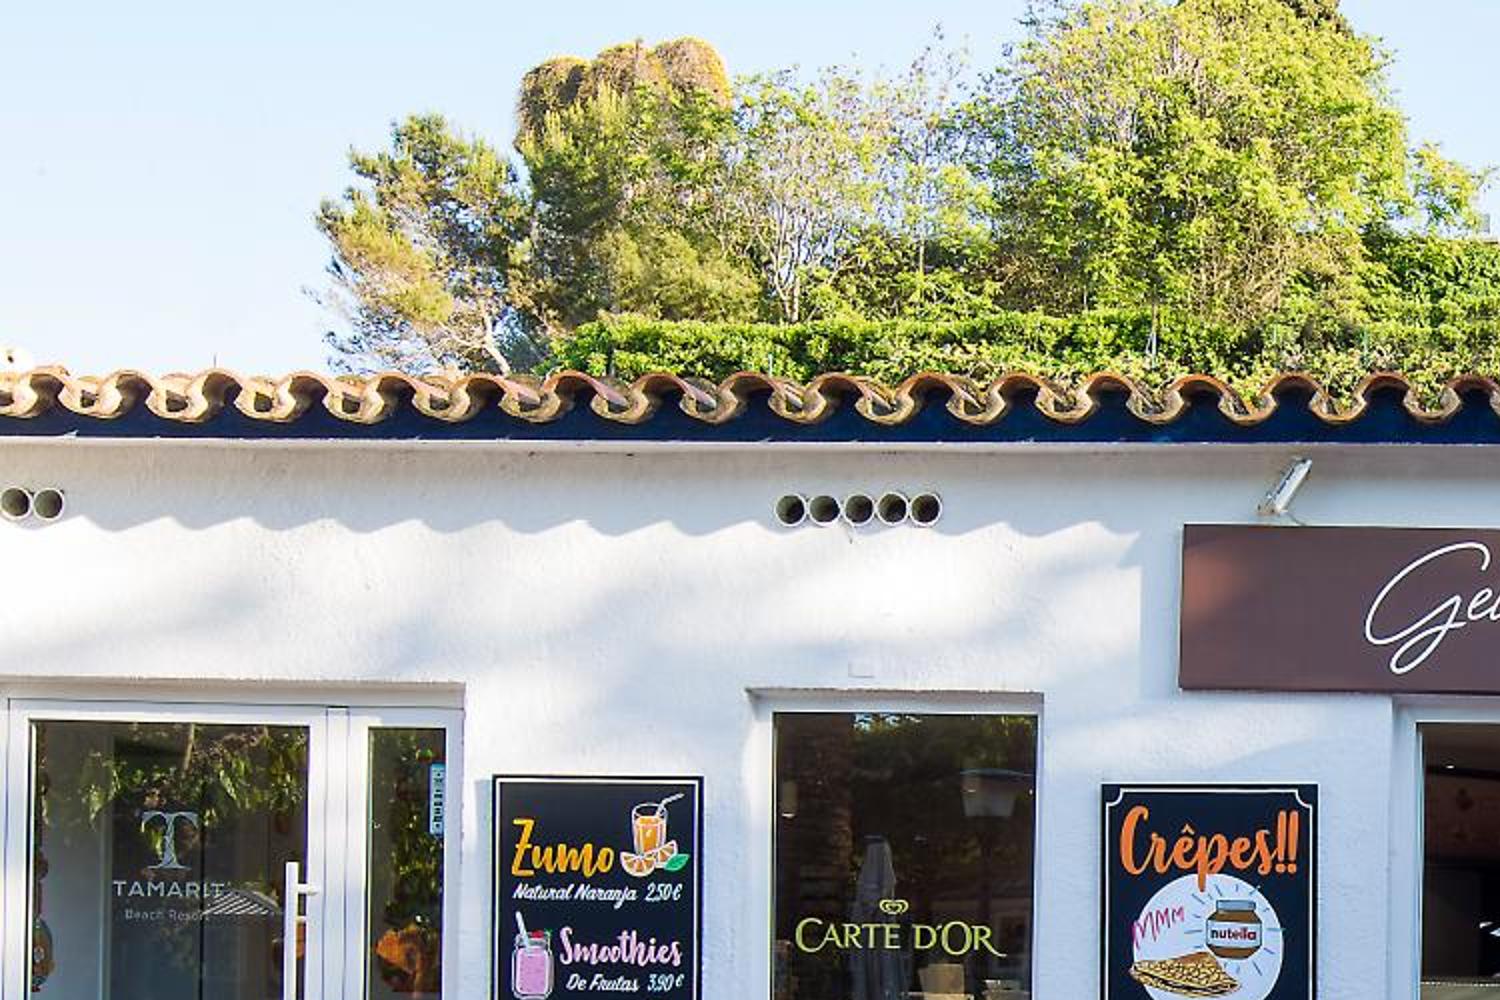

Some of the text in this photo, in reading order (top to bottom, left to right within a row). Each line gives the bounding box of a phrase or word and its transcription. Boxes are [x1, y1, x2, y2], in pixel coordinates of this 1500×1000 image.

[511, 818, 614, 878] Zumo
[1120, 805, 1299, 893] Crêpes!!
[113, 881, 225, 897] TAMARIT
[512, 883, 574, 901] Natural
[574, 883, 638, 909] Naranja
[559, 926, 683, 966] Smoothies
[795, 917, 1007, 957] CARTE D'OR
[1210, 927, 1257, 941] nutella
[566, 973, 587, 991] De
[589, 973, 640, 991] Frutas
